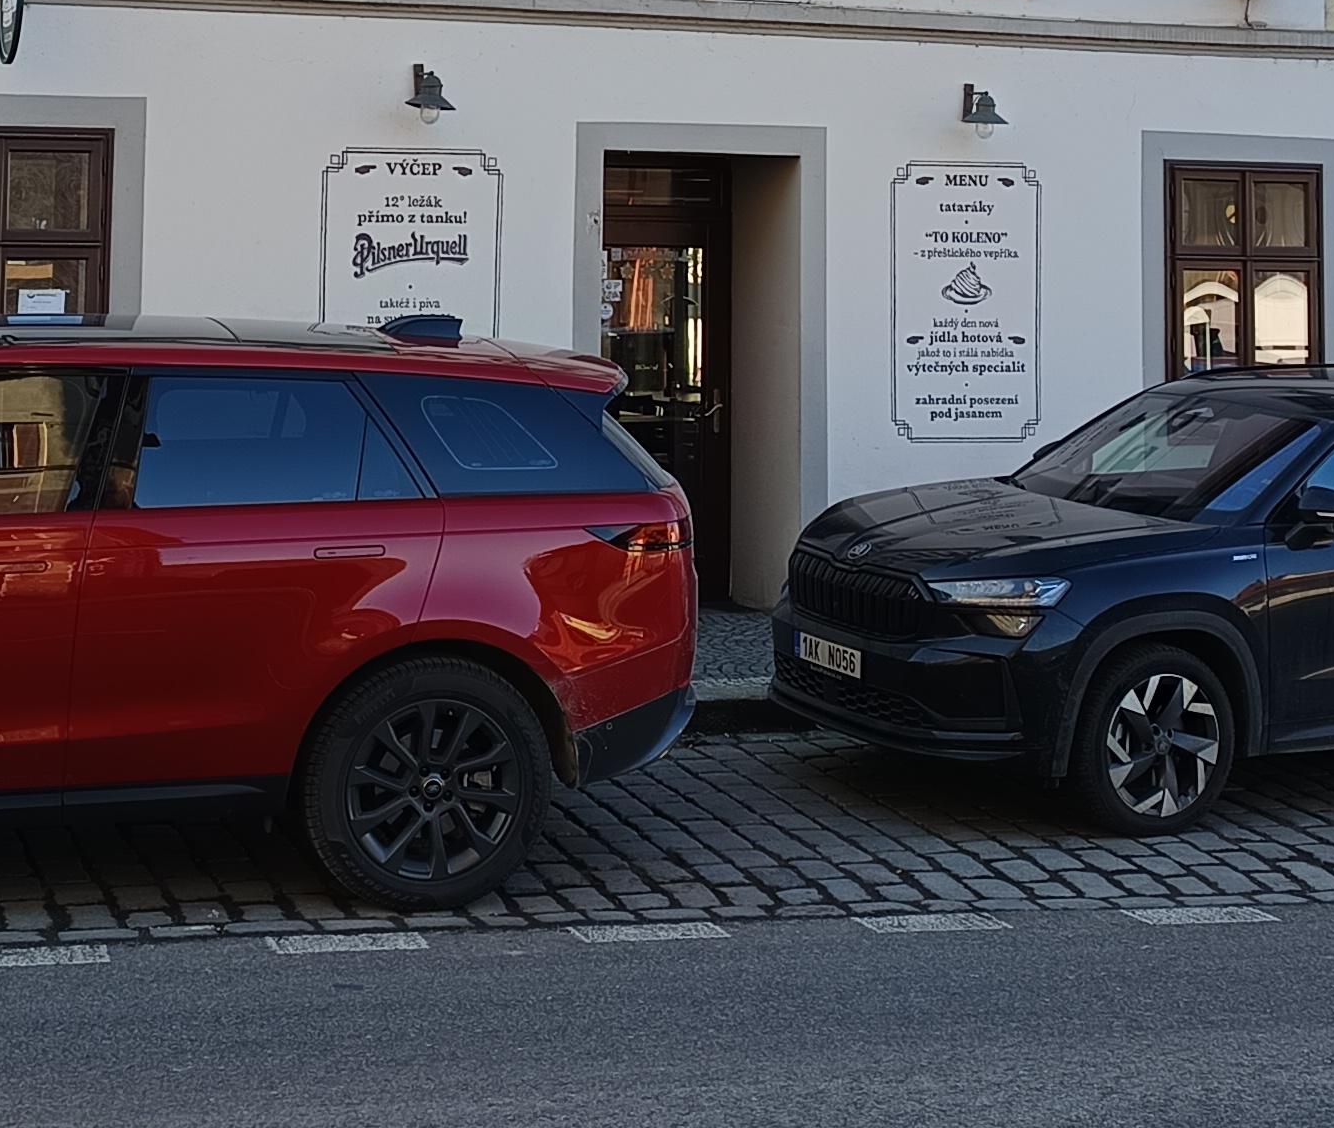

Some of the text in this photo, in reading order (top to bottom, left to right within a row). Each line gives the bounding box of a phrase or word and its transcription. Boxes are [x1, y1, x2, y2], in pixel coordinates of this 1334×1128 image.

[385, 158, 443, 176] VÝČEP
[944, 174, 989, 187] MENU
[407, 195, 443, 208] ležák
[939, 200, 995, 216] tataráky
[357, 210, 468, 226] přímo z tanku!
[352, 231, 469, 278] Pilsner Urquell
[920, 249, 927, 258] z
[927, 247, 982, 259] přeštického
[983, 248, 1020, 260] vepříka
[379, 297, 441, 311] taktéž i piva
[367, 315, 382, 325] na
[933, 318, 1000, 330] každý den nová
[928, 331, 1003, 346] jídla hotová
[916, 347, 941, 360] jakož
[942, 349, 952, 358] to
[980, 347, 1015, 358] nabídka
[906, 360, 1027, 377] výtečných specialit
[914, 394, 1019, 408] zahradní posezení
[930, 407, 1004, 422] pod jasanem
